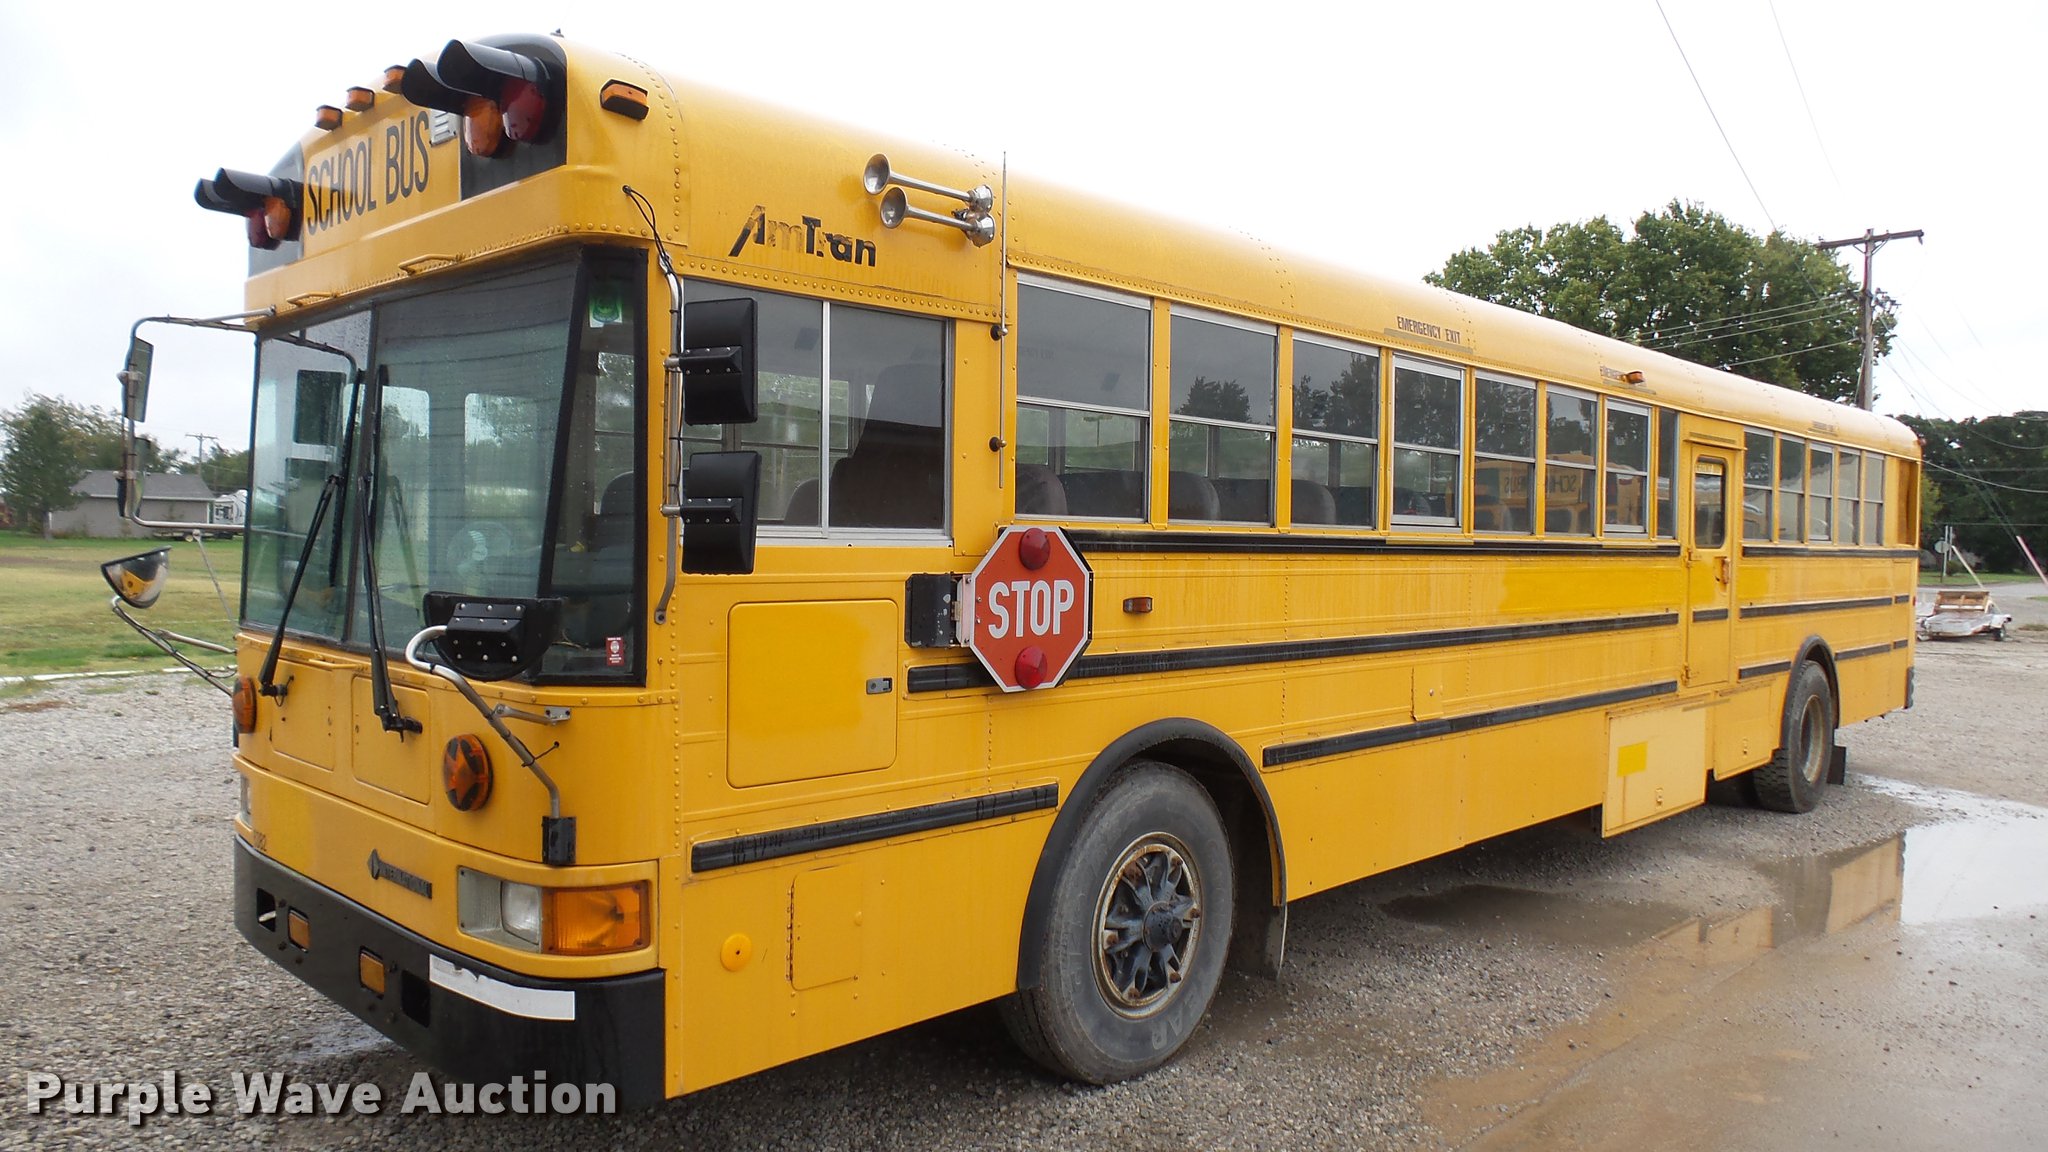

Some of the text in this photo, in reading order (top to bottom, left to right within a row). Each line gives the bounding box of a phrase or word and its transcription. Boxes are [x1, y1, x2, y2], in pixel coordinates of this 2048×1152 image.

[307, 111, 429, 235] SCHOOL BUS
[1396, 316, 1461, 344] EMERGENCY EXIT
[987, 579, 1075, 639] STOP
